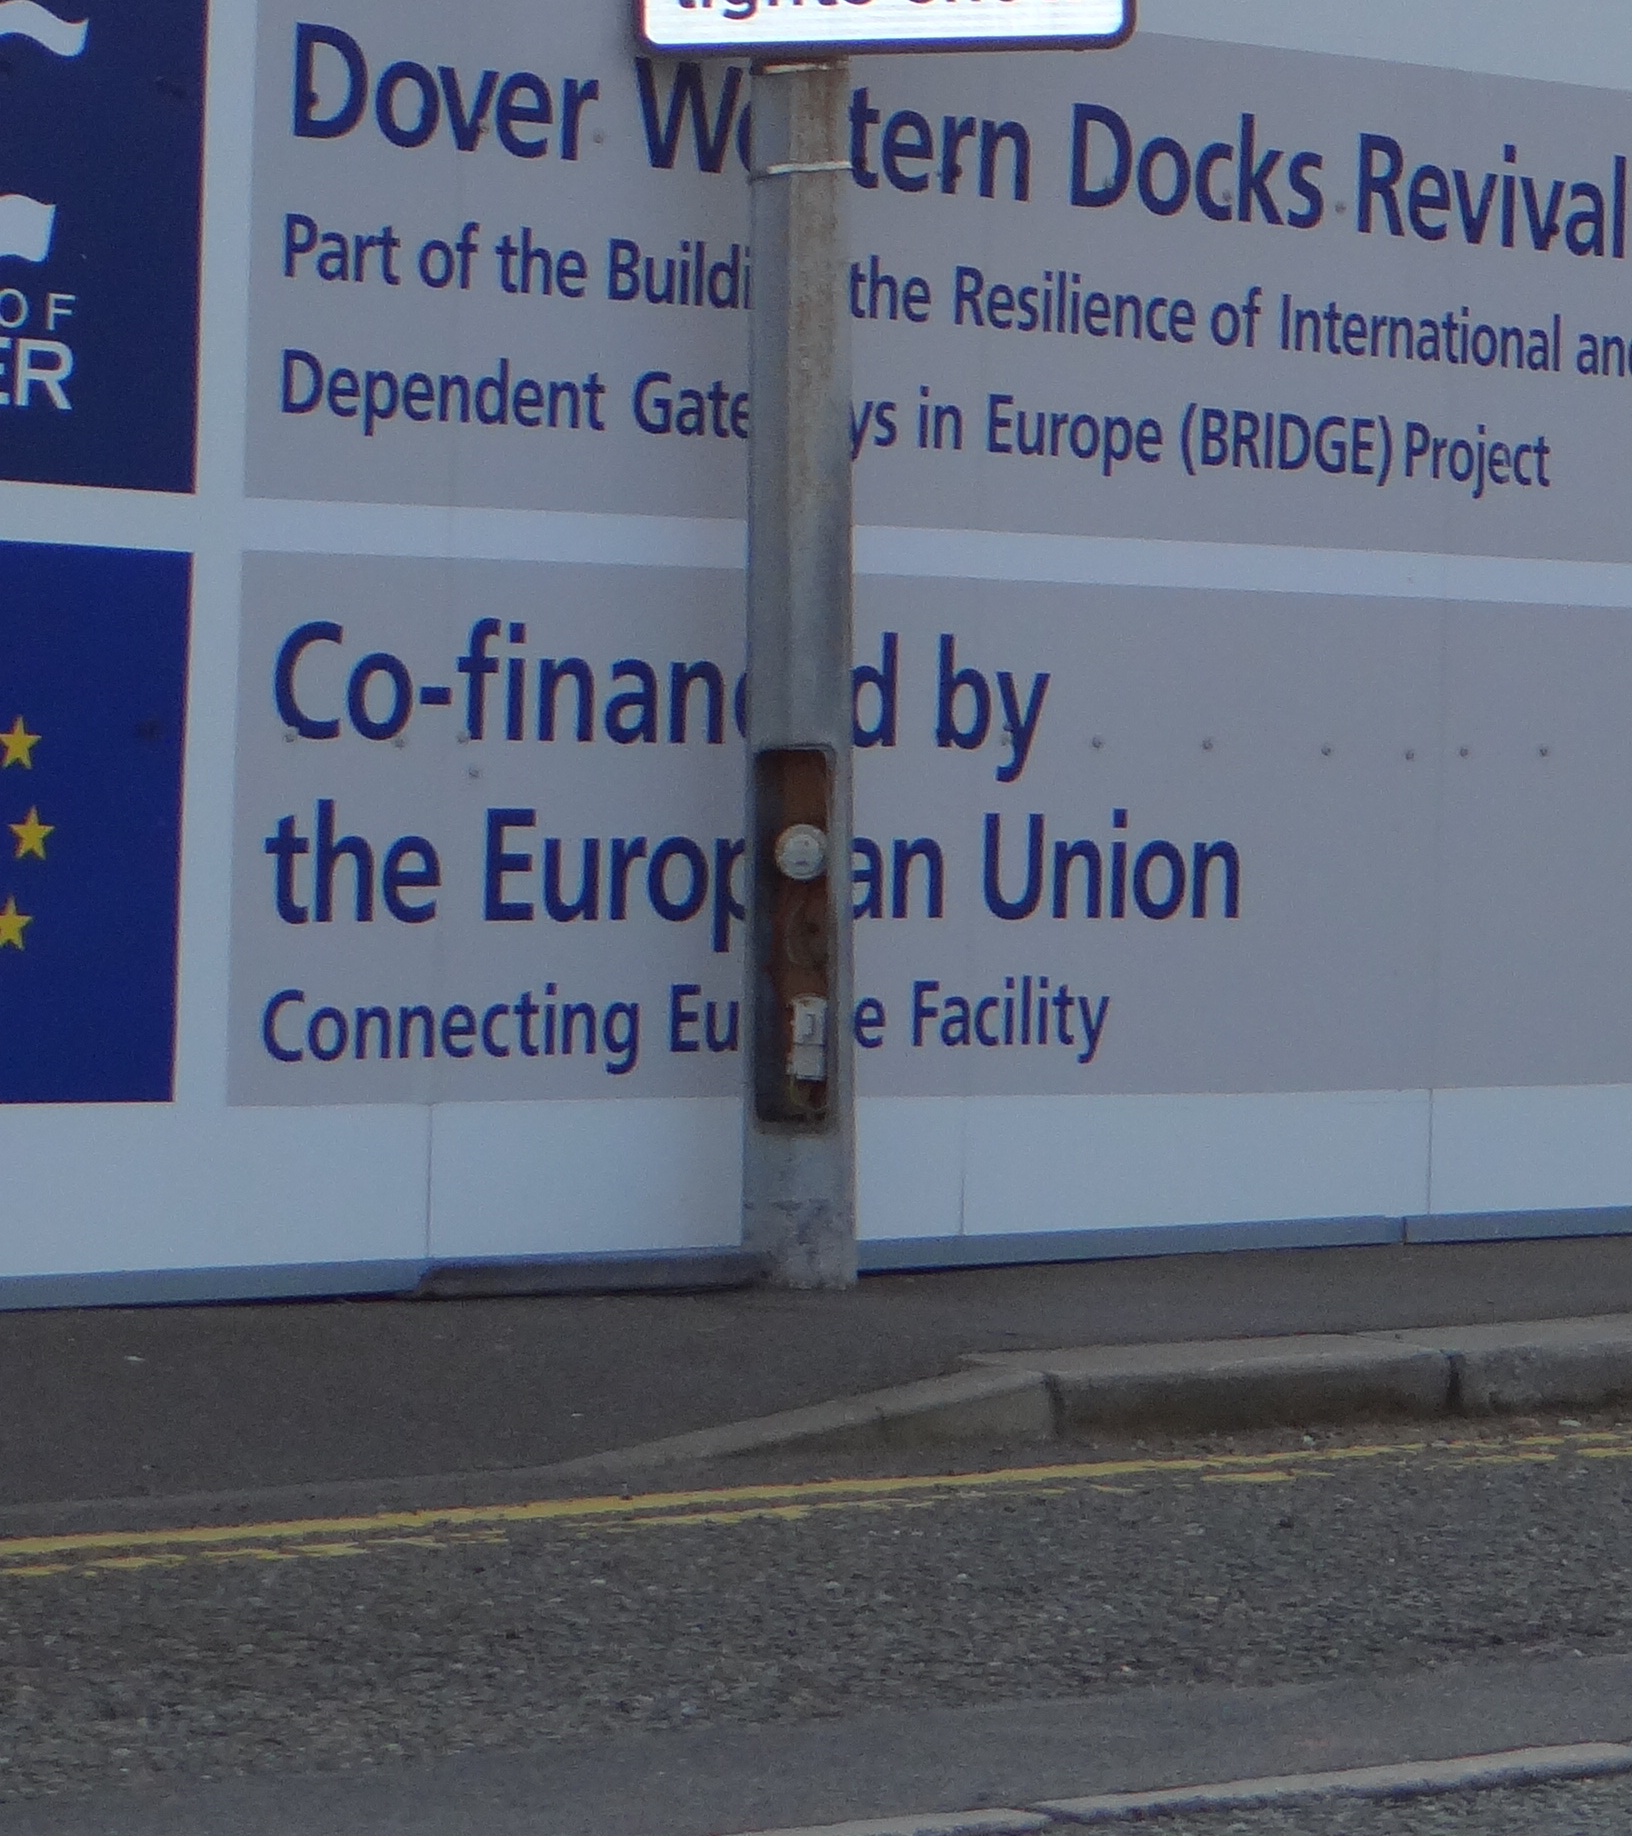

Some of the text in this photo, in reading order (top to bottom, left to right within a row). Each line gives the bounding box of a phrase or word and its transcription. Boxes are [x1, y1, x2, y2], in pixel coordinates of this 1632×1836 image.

[293, 22, 1627, 259] Dover Wtern Docks Revival
[283, 213, 400, 286] Part
[418, 221, 480, 290] of
[496, 226, 586, 298] the
[608, 238, 750, 310] Buildi
[850, 254, 931, 323] the
[953, 266, 1195, 348] Resilience
[1210, 286, 1261, 347] of
[1280, 293, 1560, 372] International
[281, 348, 1550, 498] Dependent Gateys in Europe (BRIDGE) Project
[274, 618, 1050, 783] Co-finand by
[264, 799, 1241, 952] the Europan Union
[262, 975, 1110, 1075] Connecting Eue Facility
